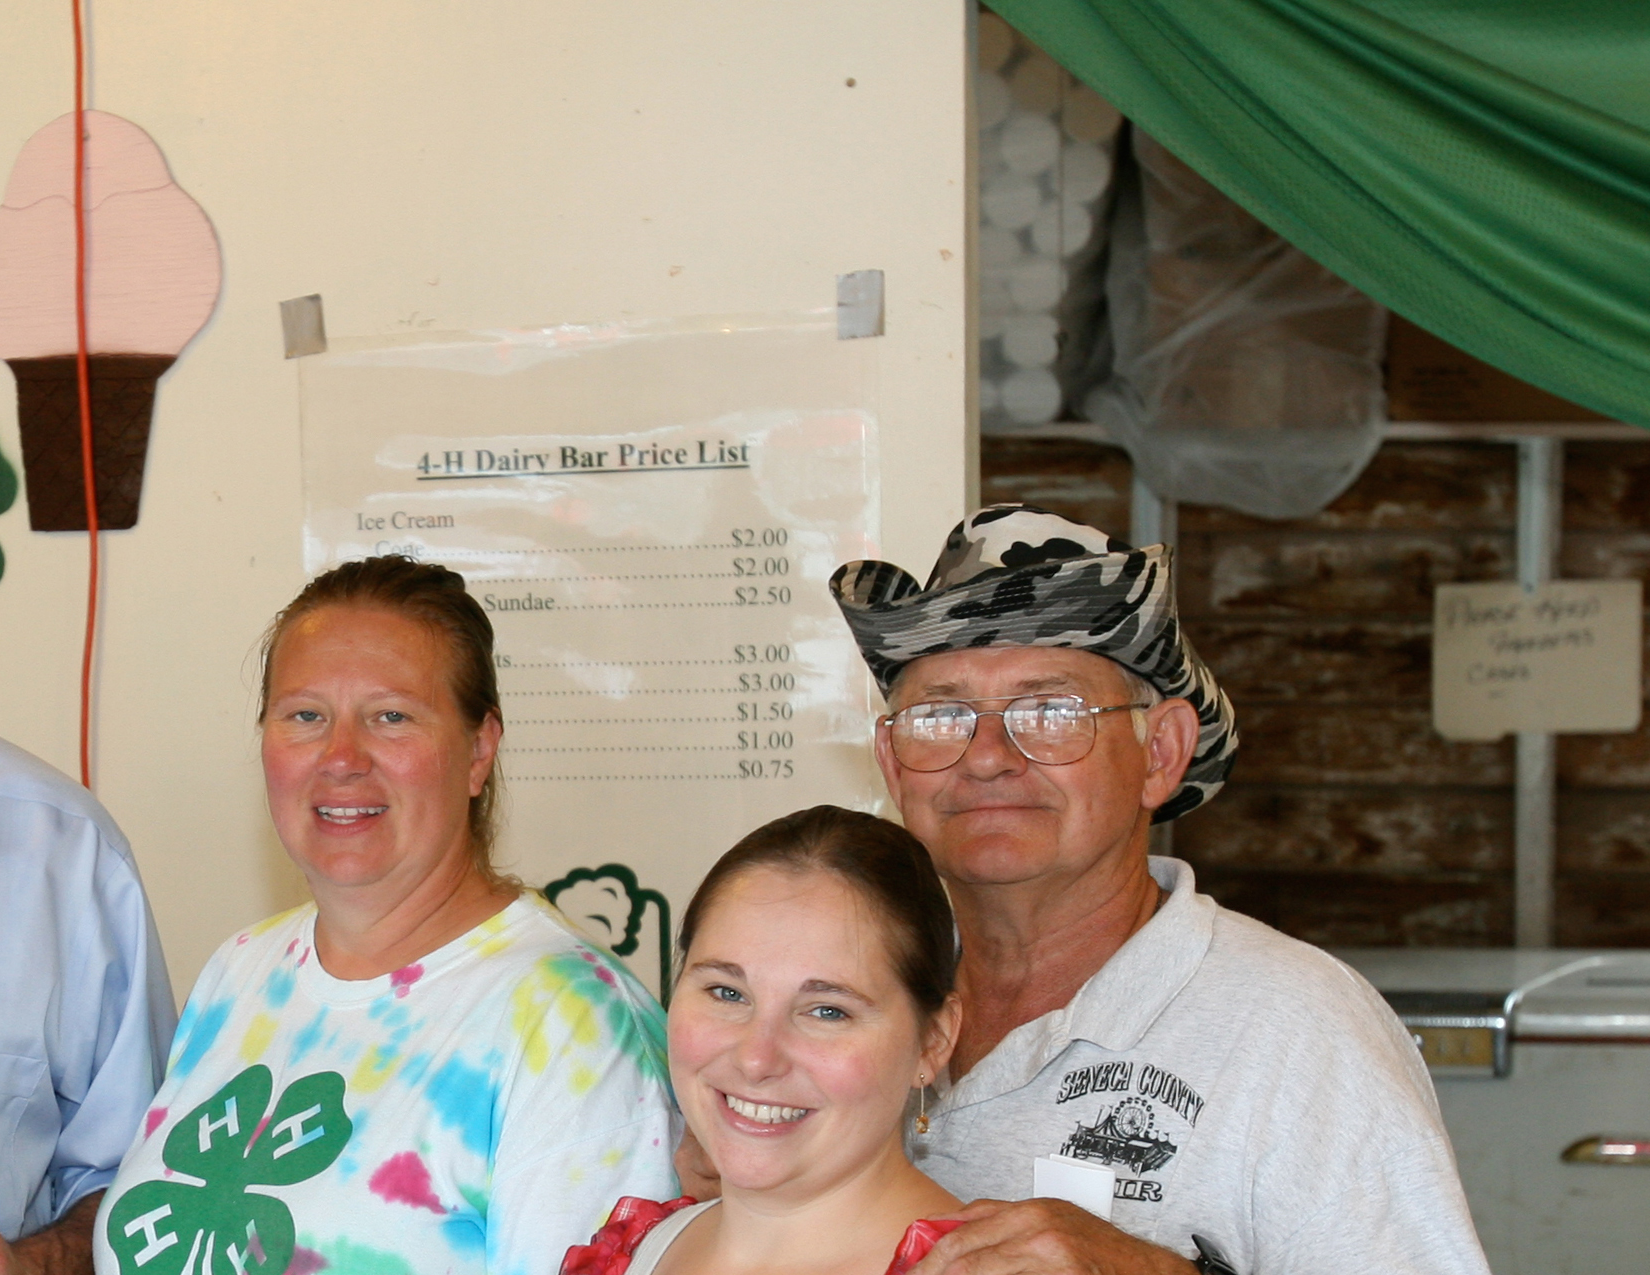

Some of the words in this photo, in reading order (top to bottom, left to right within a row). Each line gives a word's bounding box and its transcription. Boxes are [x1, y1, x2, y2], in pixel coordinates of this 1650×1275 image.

[416, 451, 465, 475] 4-H
[475, 447, 550, 473] Dairy
[559, 445, 608, 469] Bar
[617, 442, 688, 466] Price
[696, 438, 751, 464] List
[356, 512, 386, 531] Ice
[391, 510, 455, 530] Cream
[731, 527, 789, 548] $2.00
[733, 556, 790, 577] $2.00
[483, 592, 556, 612] Sundae
[735, 585, 792, 606] $2.50
[734, 644, 790, 664] $3.00
[738, 672, 795, 693] $3.00
[737, 702, 793, 722] $1.50
[737, 730, 794, 751] $1.00
[738, 759, 795, 779] $0.75
[1056, 1061, 1134, 1105] SENECA
[1137, 1062, 1205, 1129] COUNTY
[1114, 1177, 1163, 1202] IR
